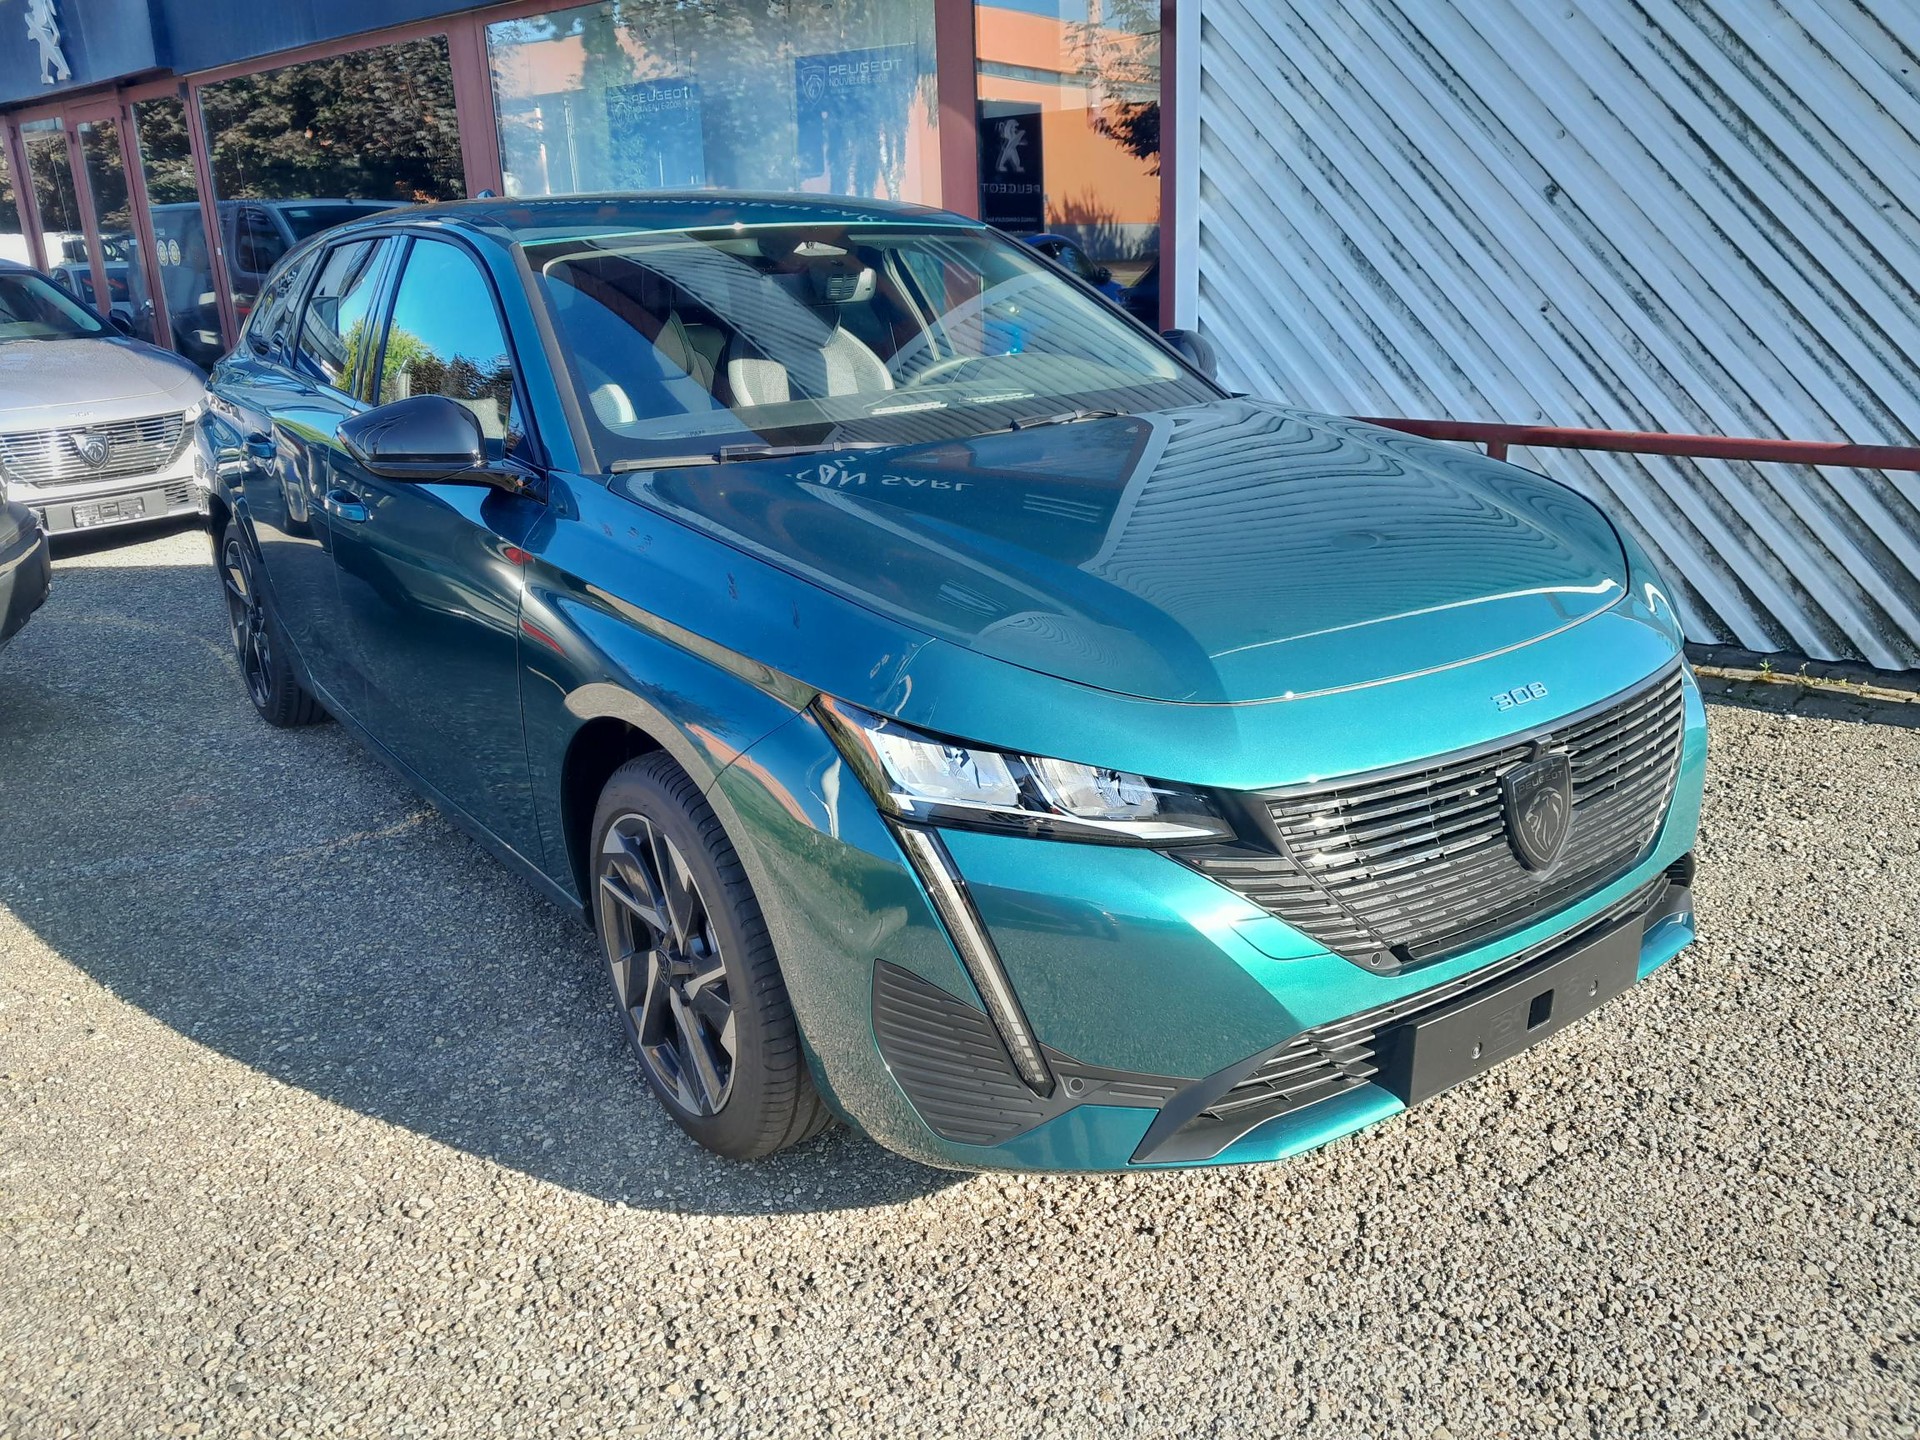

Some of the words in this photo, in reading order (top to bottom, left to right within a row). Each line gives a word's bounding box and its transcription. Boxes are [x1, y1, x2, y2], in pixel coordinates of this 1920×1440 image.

[828, 59, 903, 76] PEUGEOT
[631, 86, 689, 103] PEUGEOT
[1490, 682, 1548, 711] 308
[1519, 770, 1563, 793] PEUGEOT
